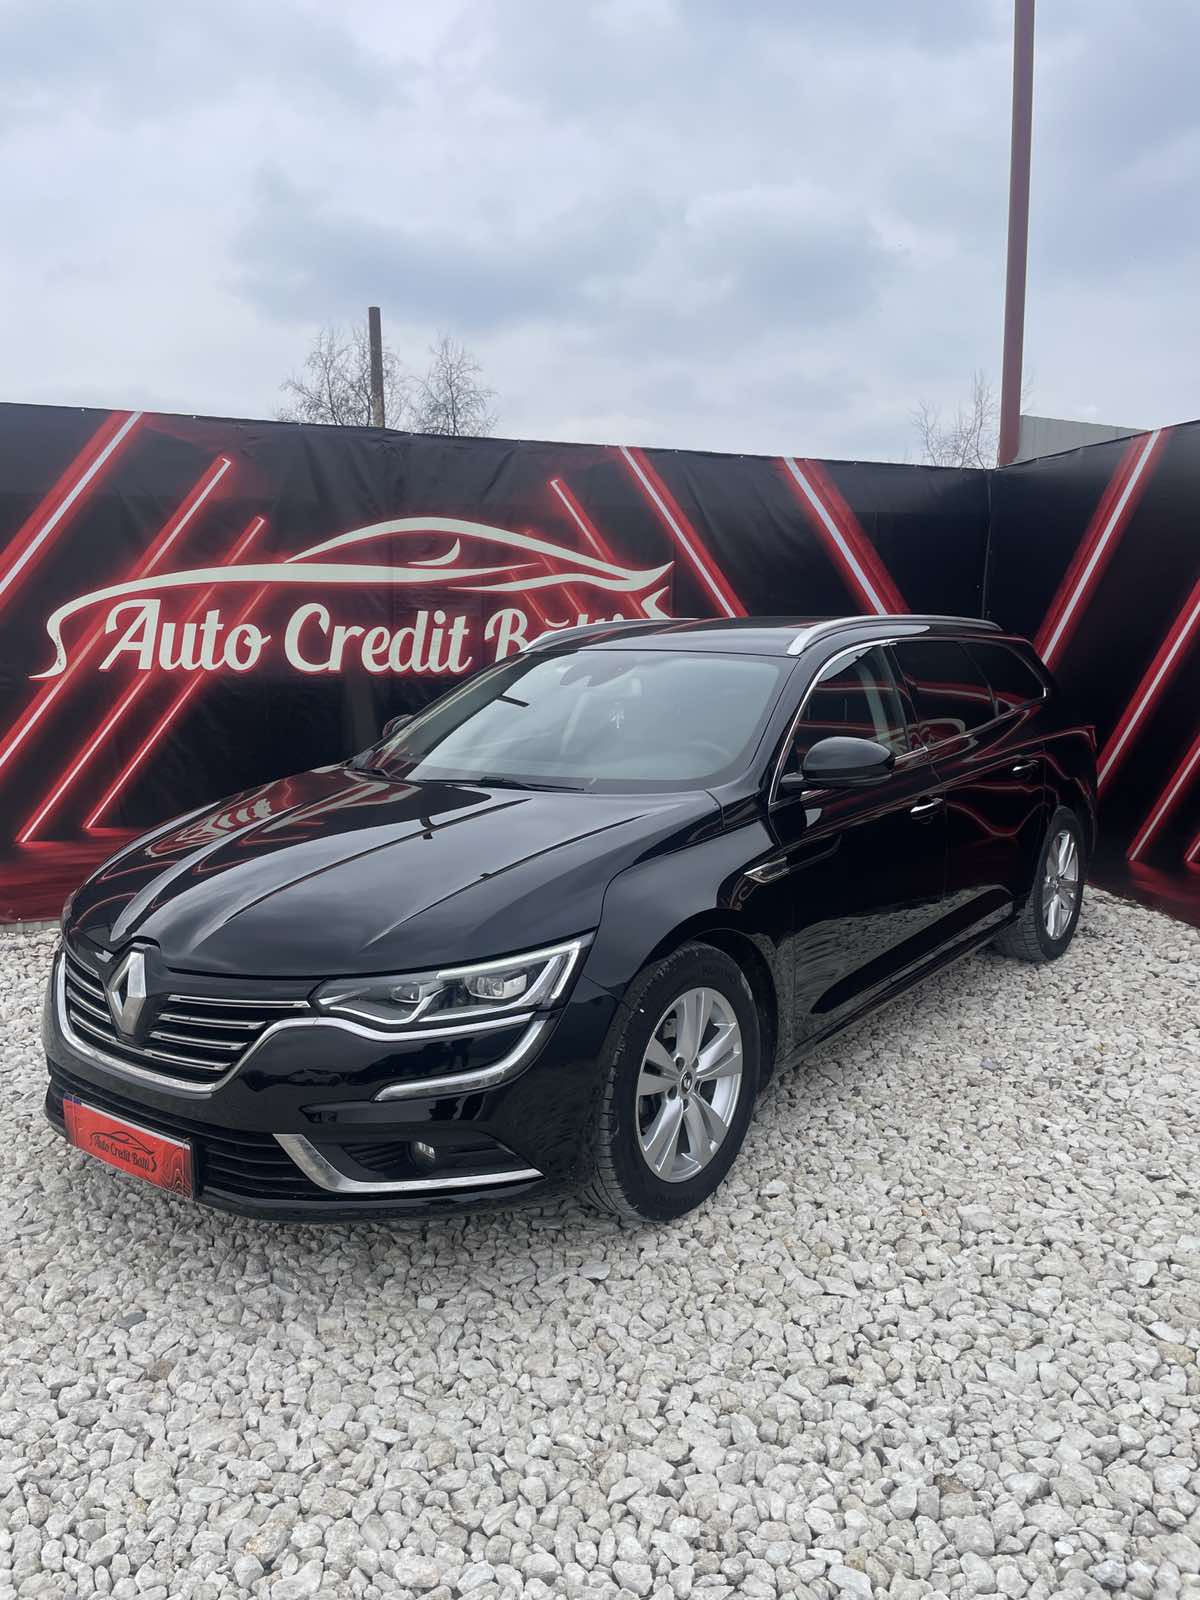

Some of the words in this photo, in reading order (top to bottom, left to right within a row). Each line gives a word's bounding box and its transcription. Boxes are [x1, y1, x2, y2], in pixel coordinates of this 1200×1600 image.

[100, 599, 271, 671] Auto
[284, 603, 473, 674] Credit
[94, 1135, 110, 1152] Auto
[111, 1143, 130, 1161] Credit
